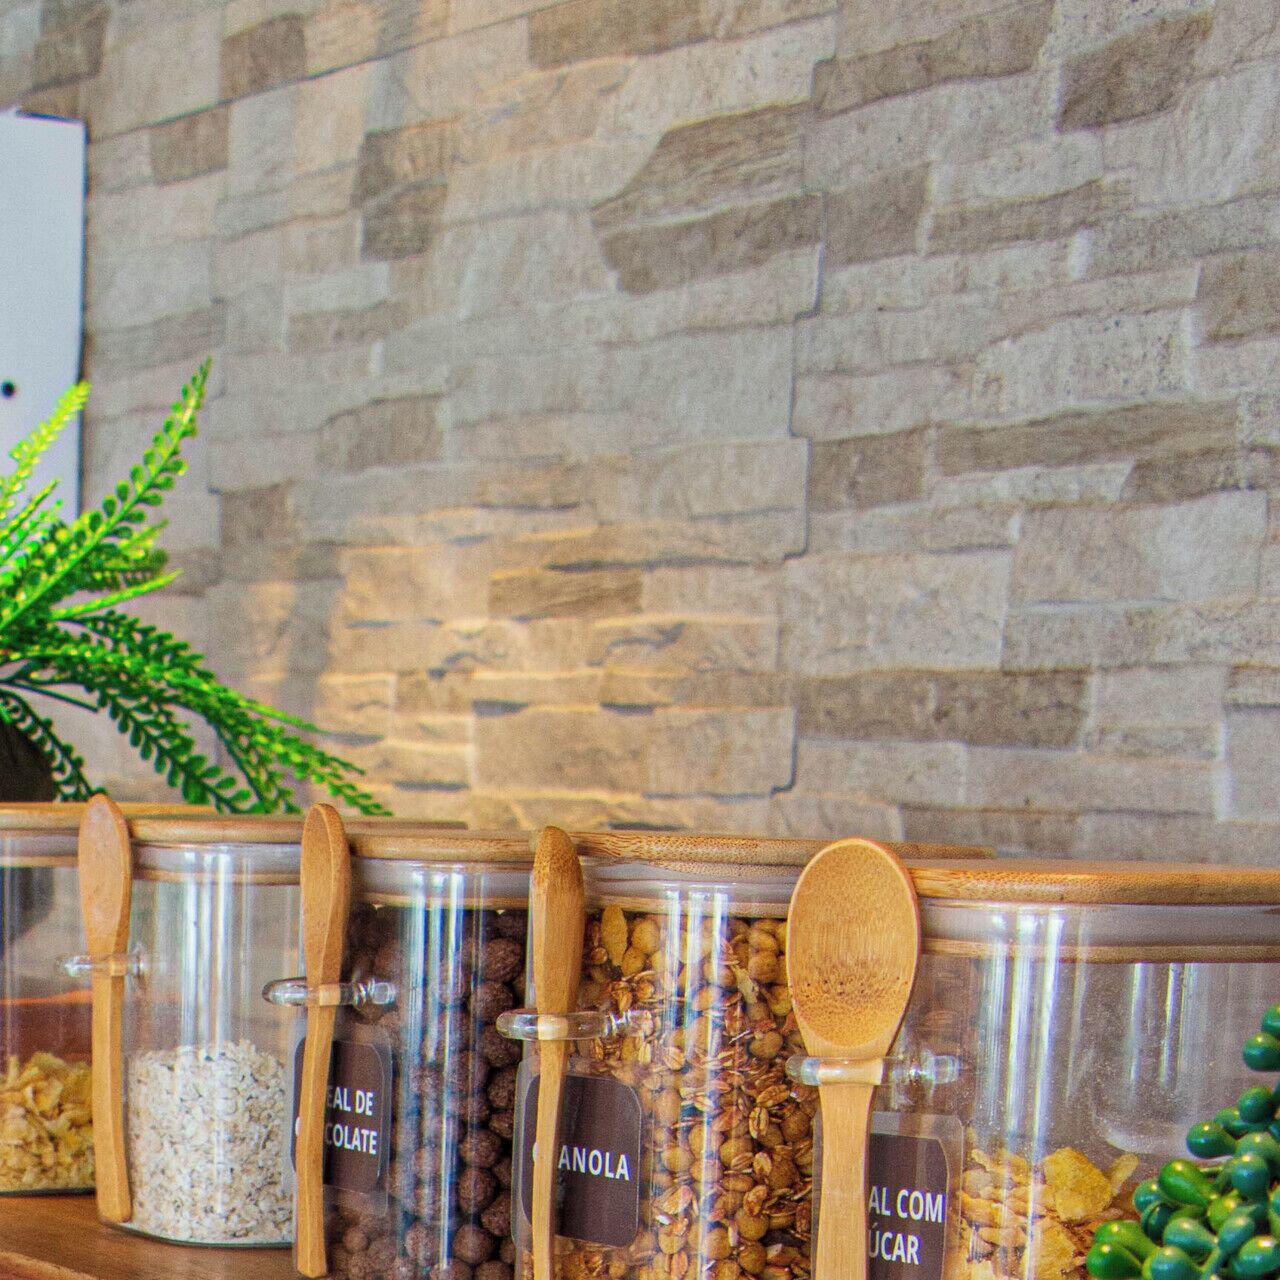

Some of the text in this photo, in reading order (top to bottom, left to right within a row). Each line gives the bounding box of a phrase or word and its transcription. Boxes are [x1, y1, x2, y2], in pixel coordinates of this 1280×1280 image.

[356, 1089, 375, 1117] DE
[295, 1116, 378, 1156] COLATE
[532, 1141, 630, 1181] ANOLA
[868, 1185, 943, 1224] AL COM
[868, 1222, 921, 1266] ÚCAR
